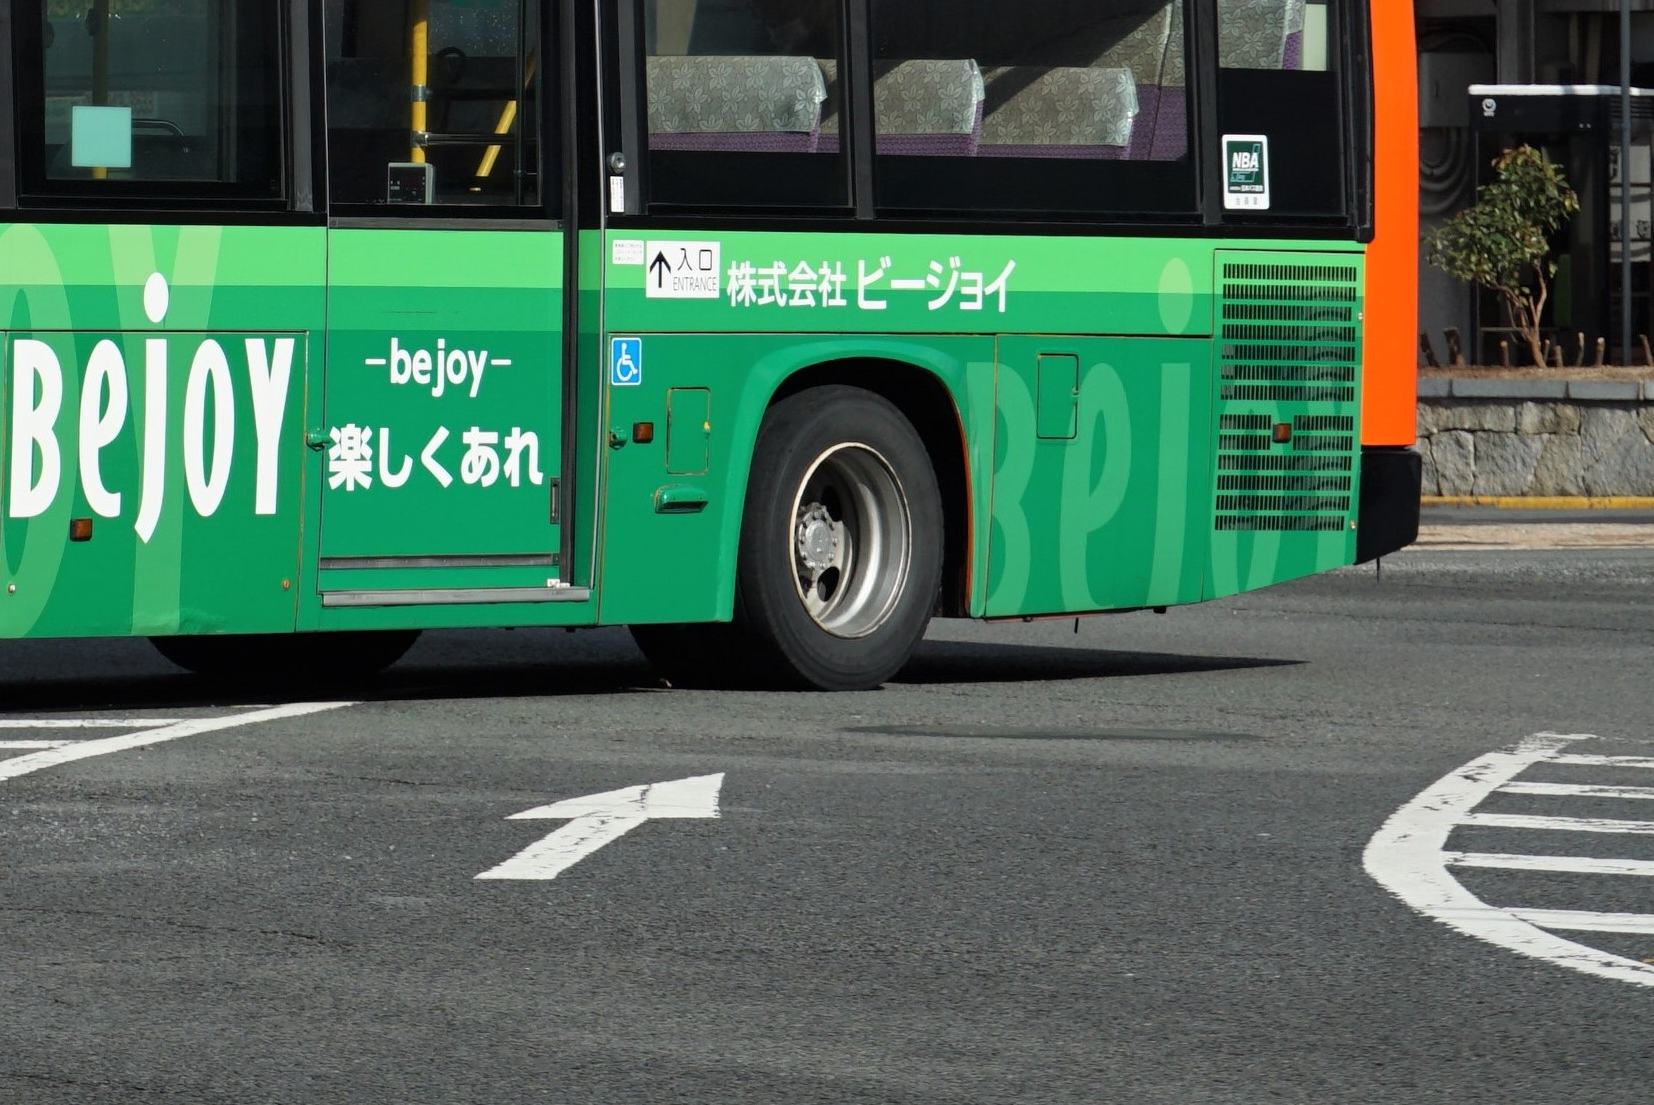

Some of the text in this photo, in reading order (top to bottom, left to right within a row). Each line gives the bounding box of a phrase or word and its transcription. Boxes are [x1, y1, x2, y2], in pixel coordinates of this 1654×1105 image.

[1232, 151, 1260, 168] NBA
[677, 247, 713, 271] 入口
[672, 276, 717, 292] ENTRANCE
[727, 255, 1016, 313] 株式会社 ビージョイ
[328, 423, 544, 492] 楽しくあれ
